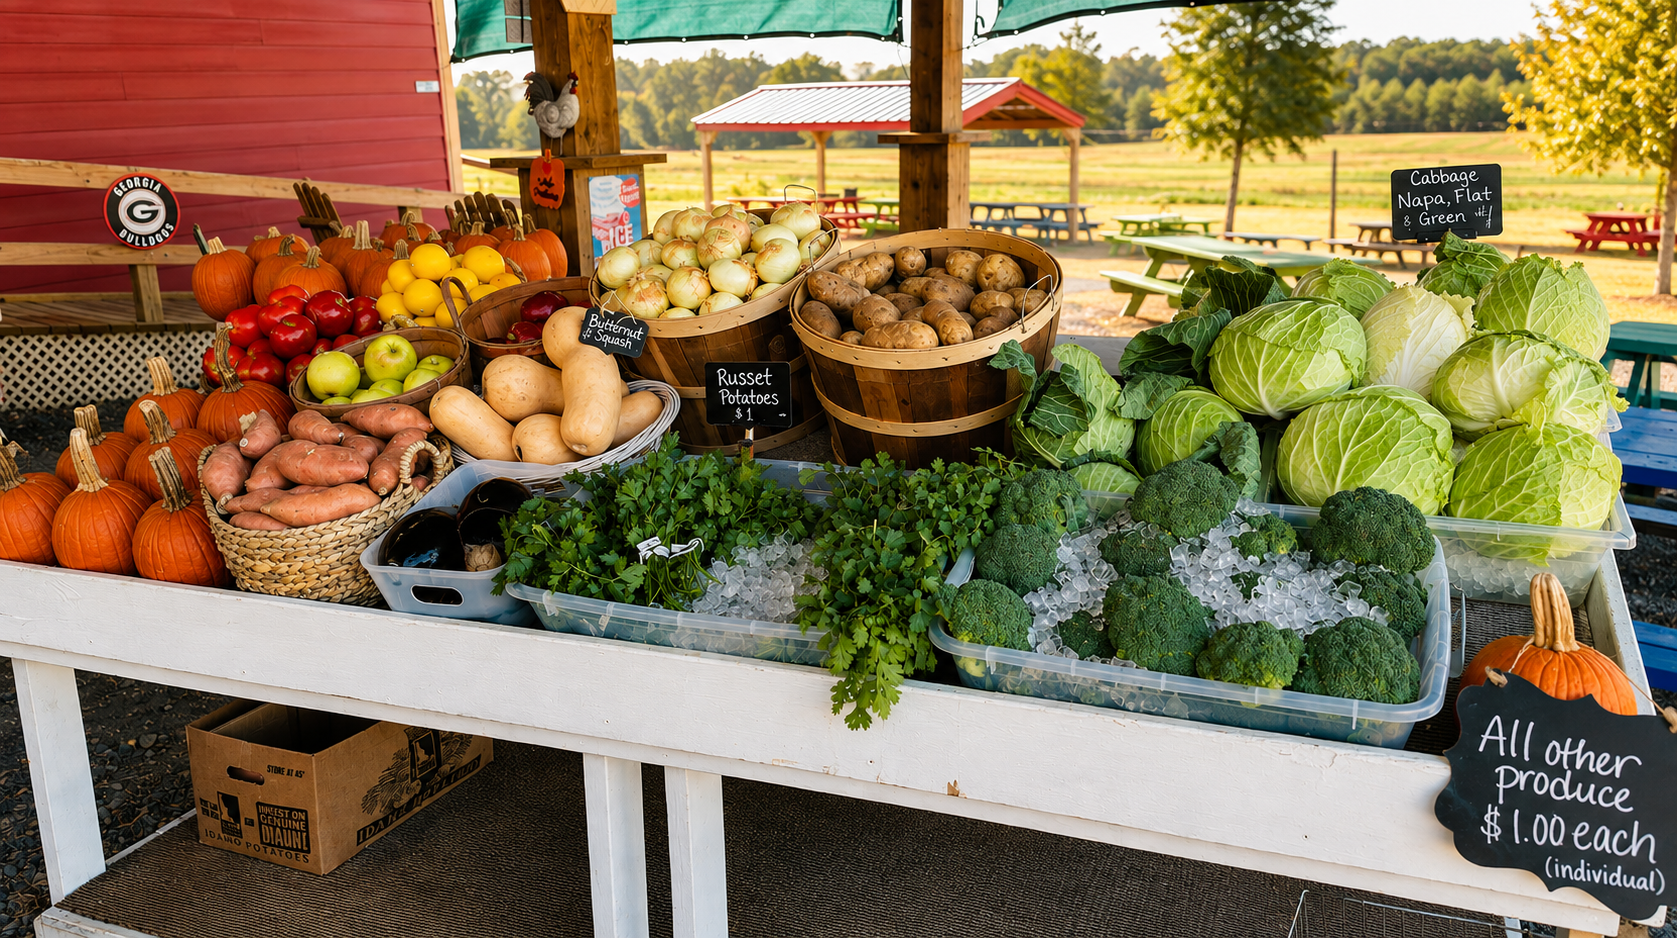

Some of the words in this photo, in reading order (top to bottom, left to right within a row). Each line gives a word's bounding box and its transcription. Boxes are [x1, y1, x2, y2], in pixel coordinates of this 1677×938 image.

[113, 177, 161, 197] GEORGIA
[1410, 169, 1479, 187] Cabbage
[1398, 191, 1451, 211] Napa,
[1454, 186, 1492, 204] Flat
[126, 199, 161, 224] G
[1419, 211, 1466, 226] Green
[588, 313, 644, 340] Butternut
[594, 328, 632, 350] Squash
[716, 367, 773, 387] Russet
[718, 388, 779, 405] Potatoes
[1478, 715, 1534, 762] All
[1545, 737, 1642, 778] other
[260, 814, 307, 832] GENUINE
[245, 841, 310, 863] POTATOES
[1571, 820, 1657, 864] each
[1545, 856, 1666, 896] (individual)
